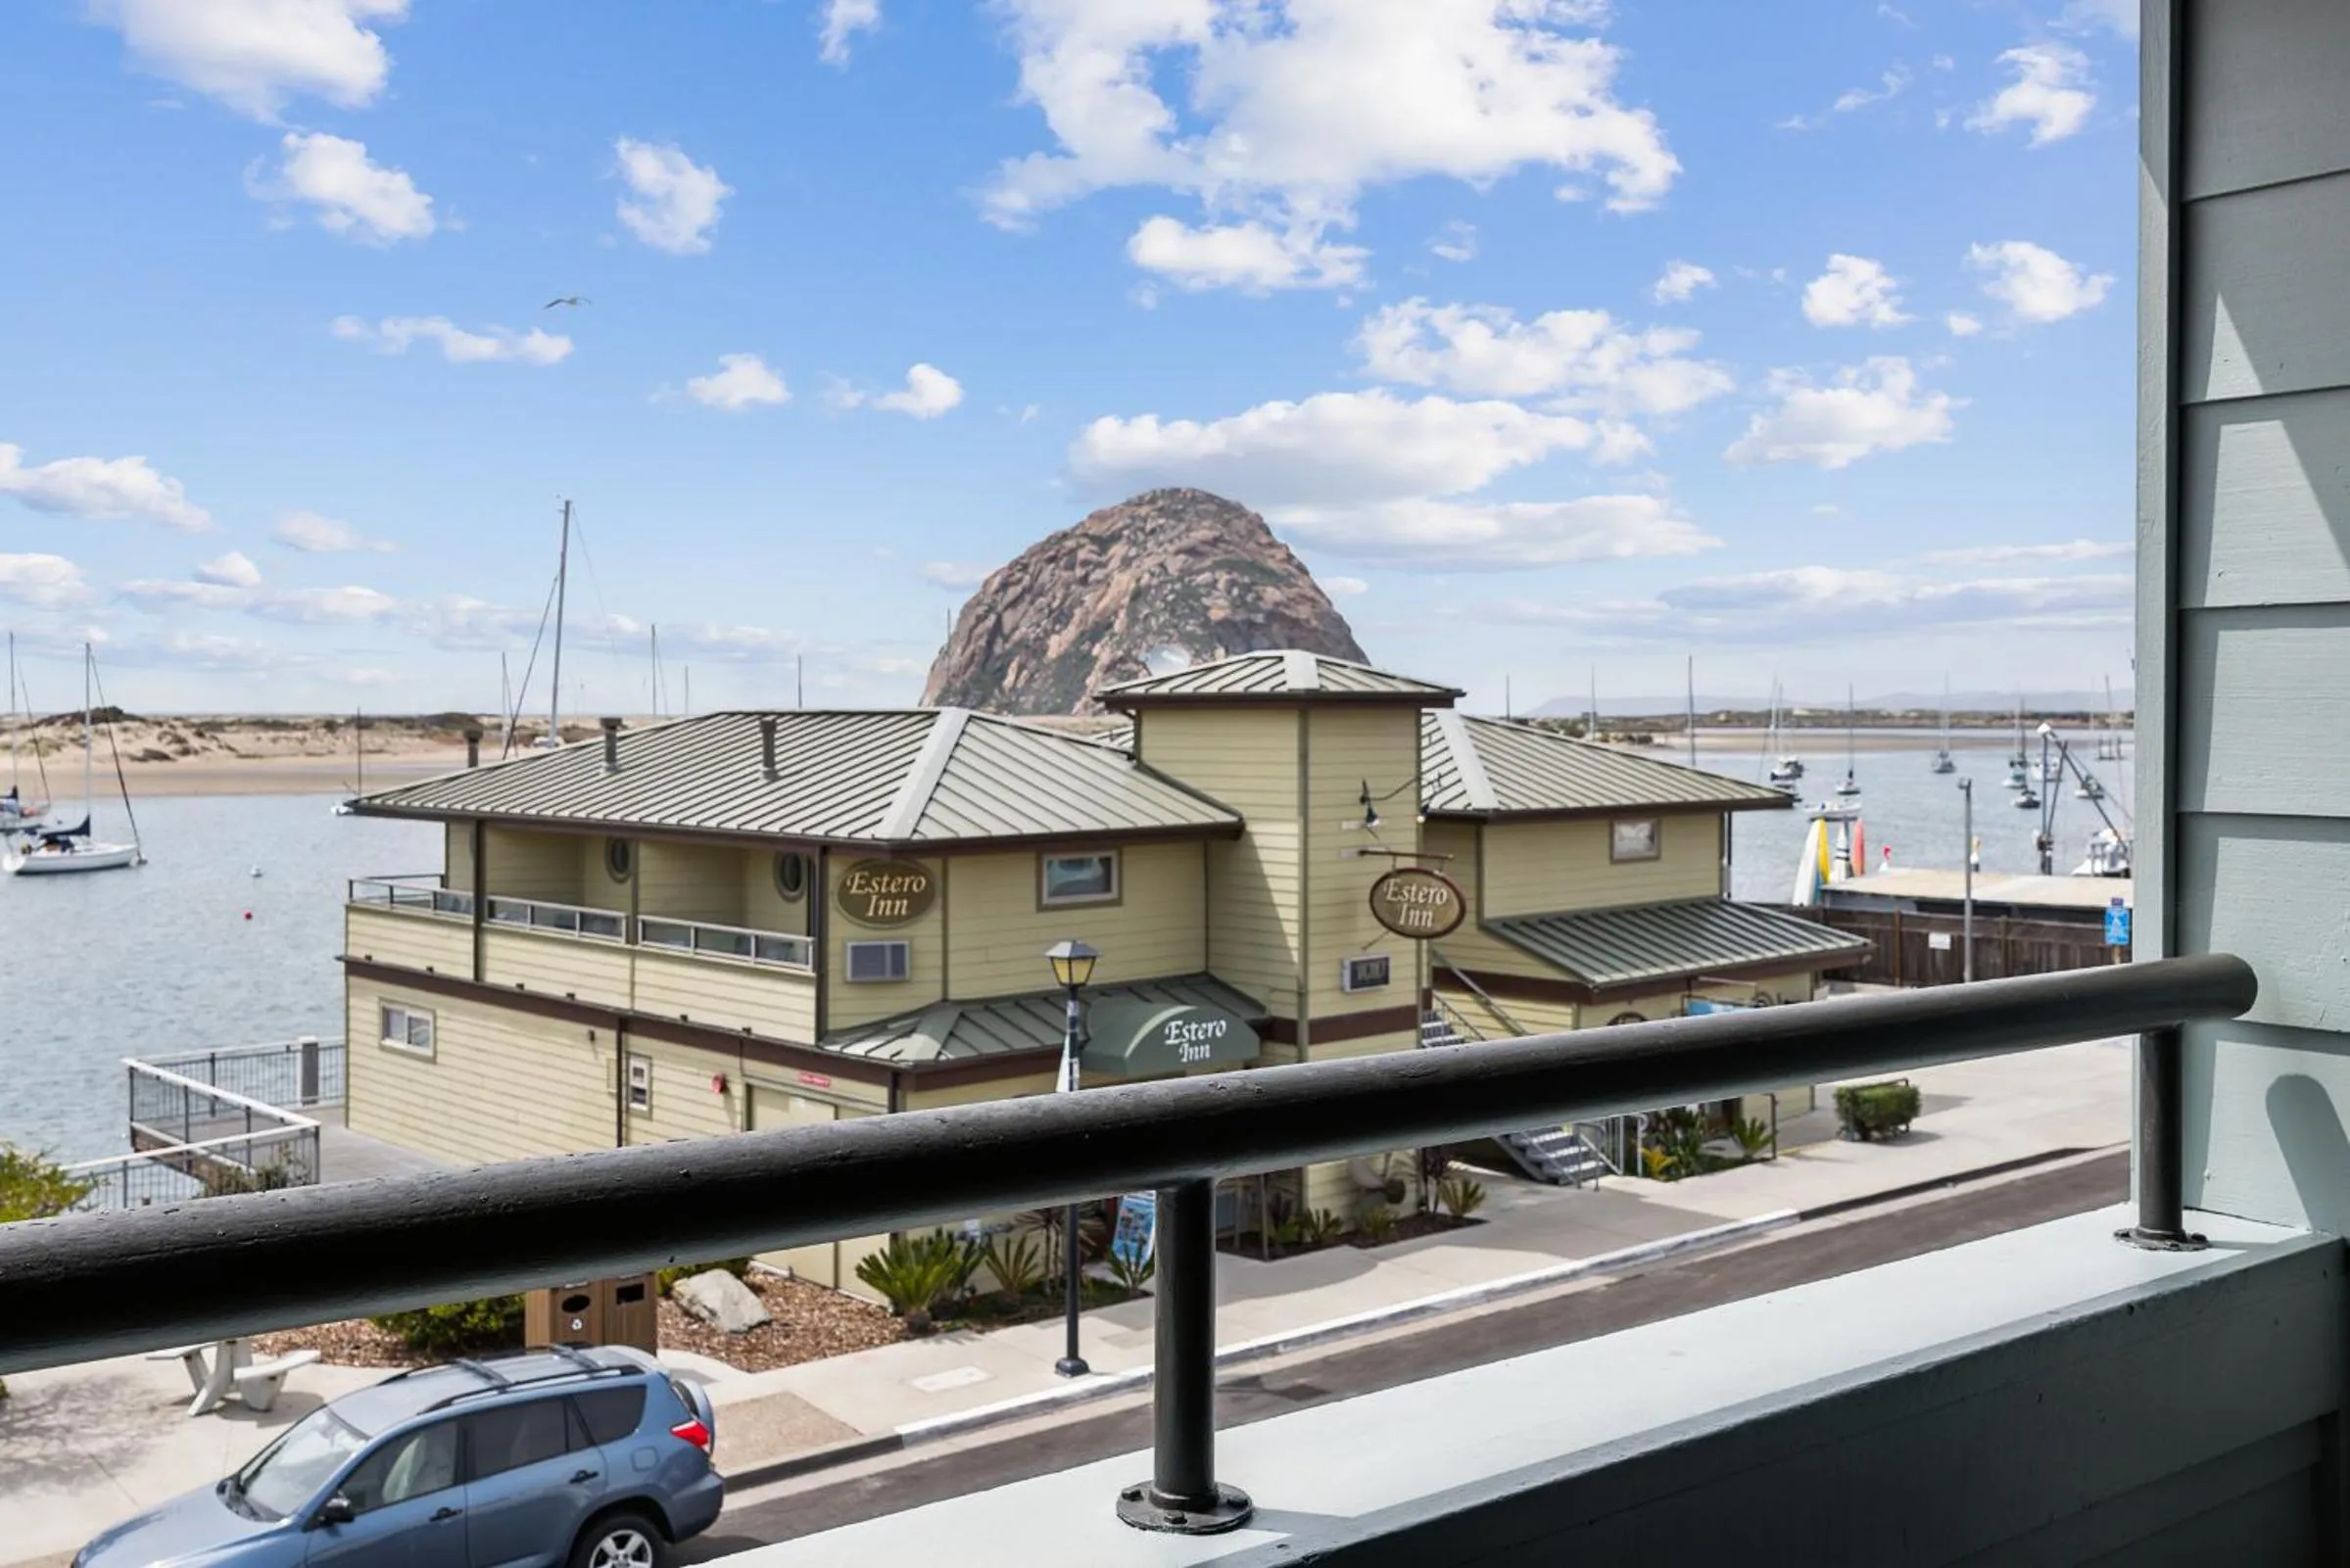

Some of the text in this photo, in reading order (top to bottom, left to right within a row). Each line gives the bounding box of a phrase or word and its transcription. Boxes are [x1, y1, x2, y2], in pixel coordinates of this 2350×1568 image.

[846, 871, 926, 894] Estero
[1383, 878, 1448, 905] Estero
[866, 894, 909, 918] Inn
[1399, 904, 1433, 927] Inn
[1164, 1019, 1226, 1045] Estero
[1178, 1042, 1211, 1063] Inn
